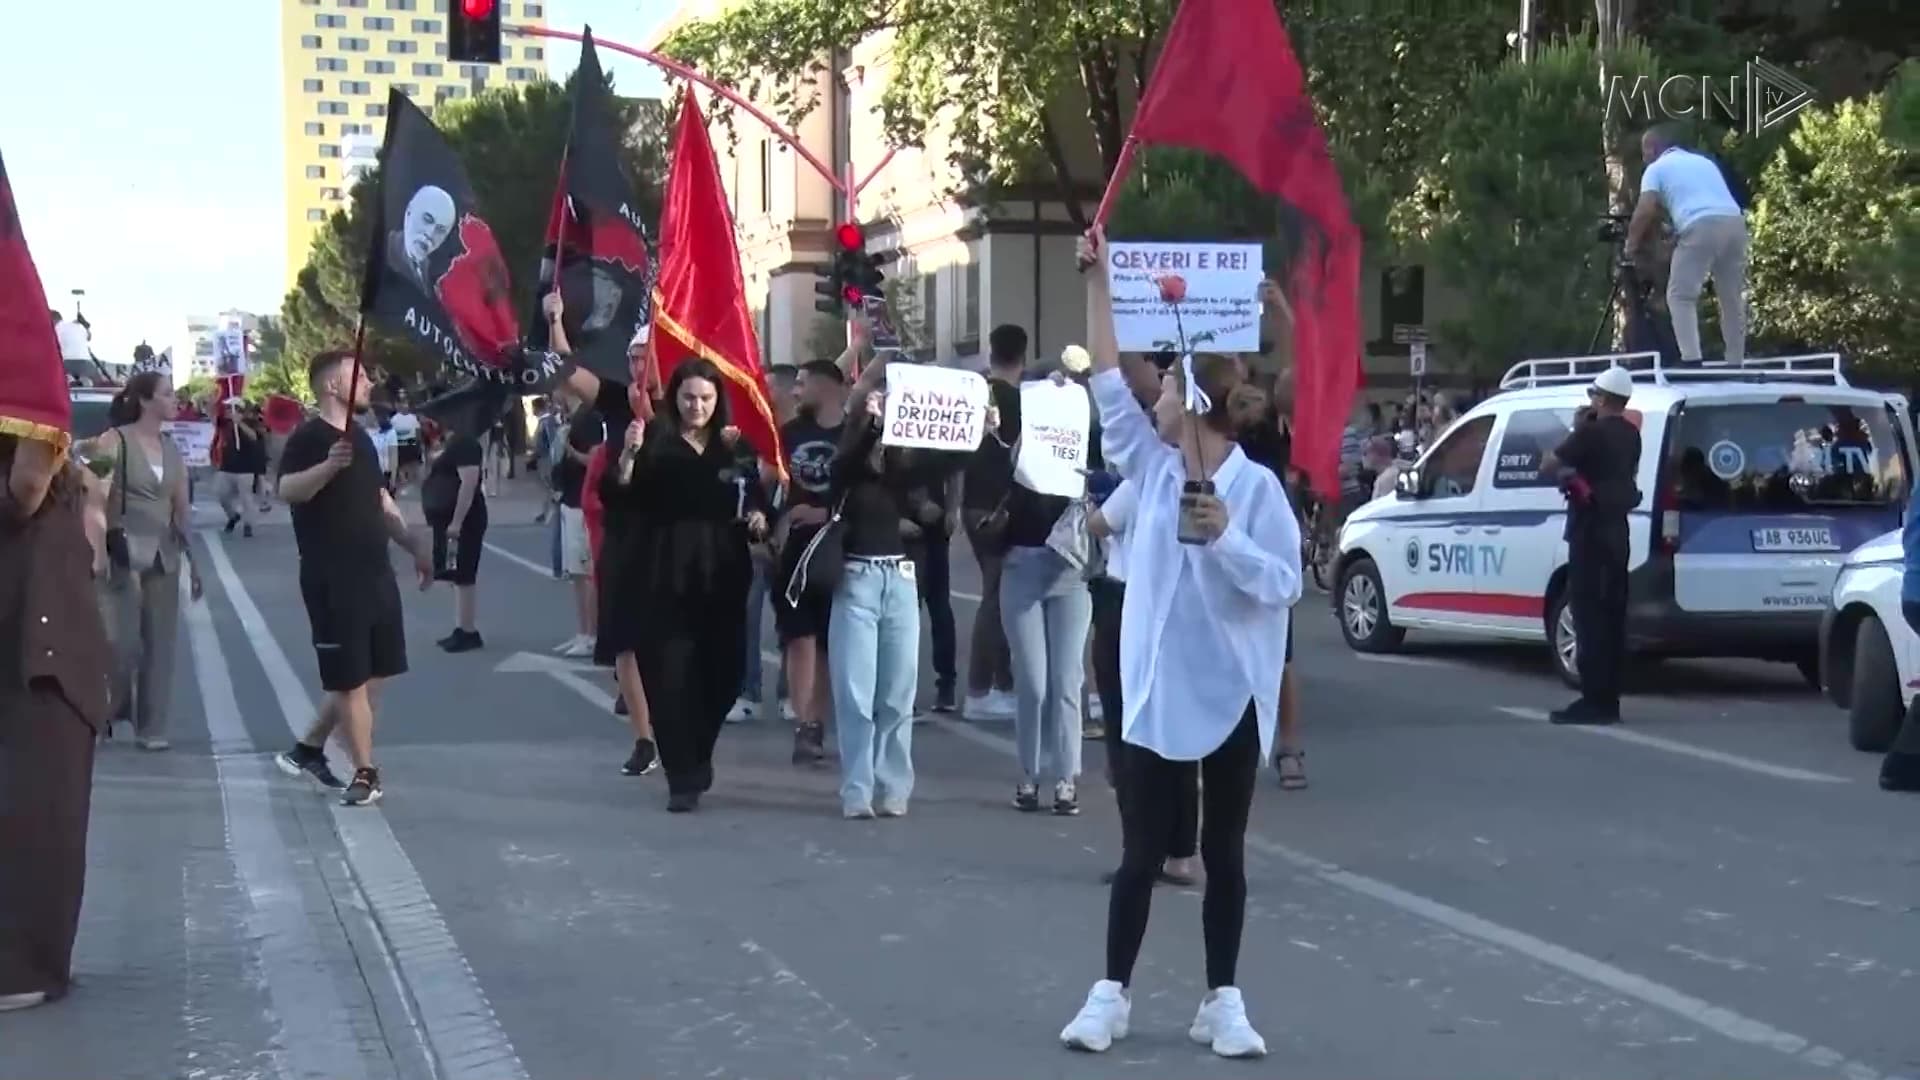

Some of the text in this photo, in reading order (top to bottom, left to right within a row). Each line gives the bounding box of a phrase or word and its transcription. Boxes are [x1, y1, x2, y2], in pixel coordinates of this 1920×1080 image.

[1111, 251, 1248, 270] QEVERI E RE!
[898, 405, 974, 424] DRIDHET
[892, 421, 974, 444] QEVERIA!
[1520, 453, 1533, 466] TV
[1838, 447, 1880, 476] TV
[1765, 531, 1782, 544] AB
[1428, 543, 1506, 575] SYRI TV
